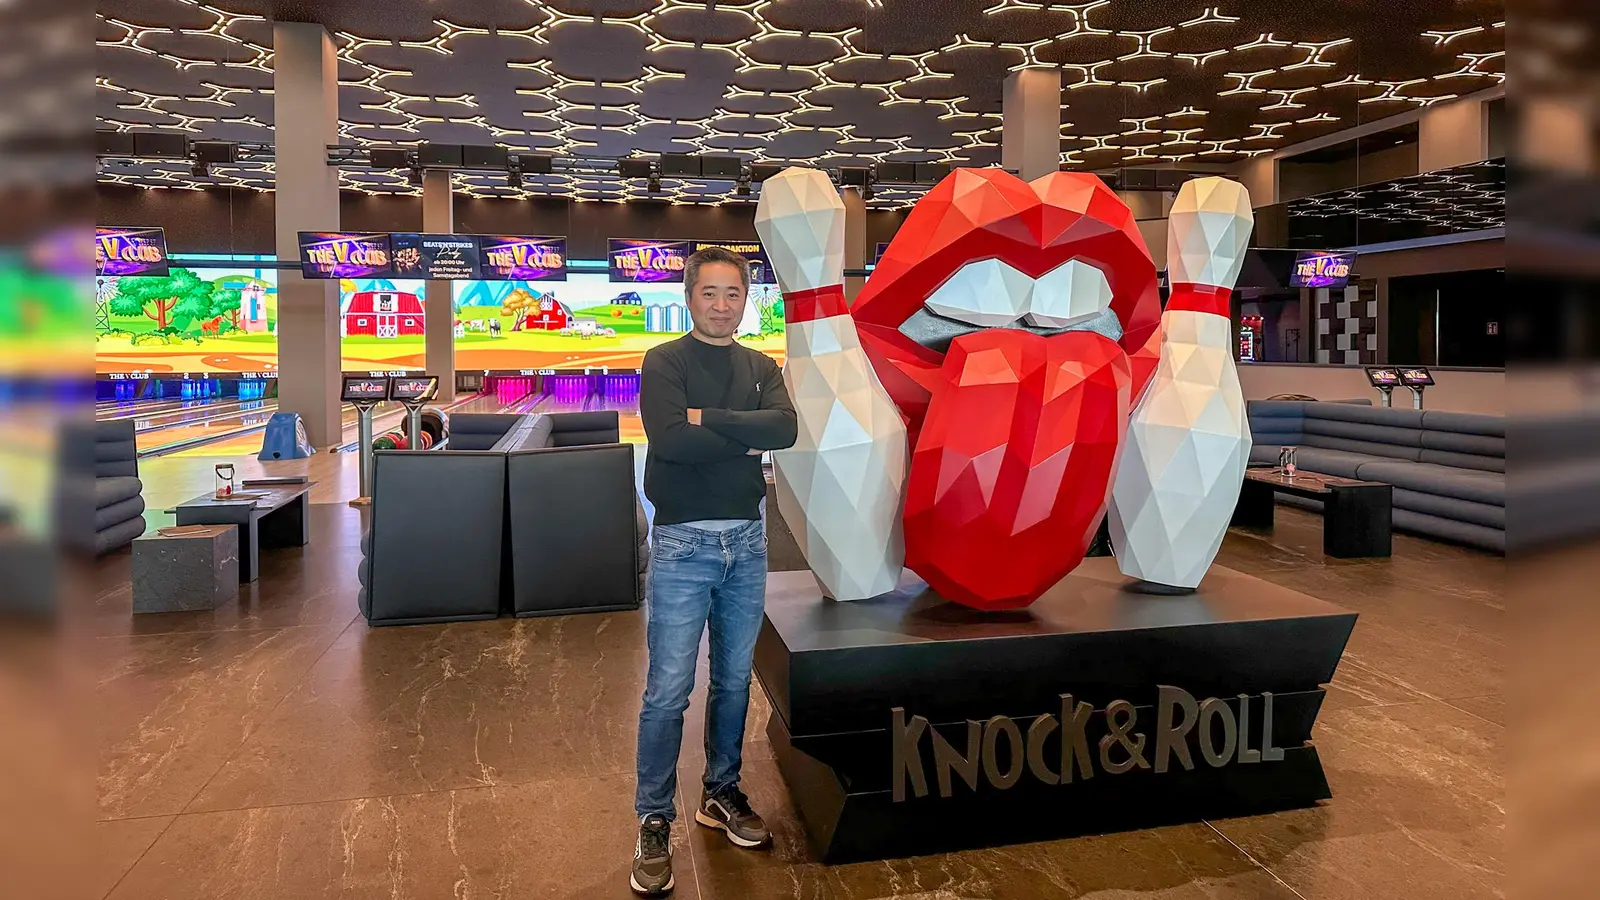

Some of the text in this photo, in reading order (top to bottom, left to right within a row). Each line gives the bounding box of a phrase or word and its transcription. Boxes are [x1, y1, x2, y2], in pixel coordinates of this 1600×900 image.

[121, 246, 161, 262] CLUB
[306, 249, 335, 265] THE
[332, 241, 350, 263] V
[350, 249, 387, 265] CLUB
[486, 252, 514, 268] THE
[511, 245, 528, 266] V
[528, 253, 562, 268] CLUB
[614, 255, 639, 269] THE
[637, 248, 653, 268] V
[652, 255, 684, 271] CLUB
[1297, 263, 1316, 276] THE
[1316, 258, 1328, 275] V
[1324, 264, 1349, 277] CLUB
